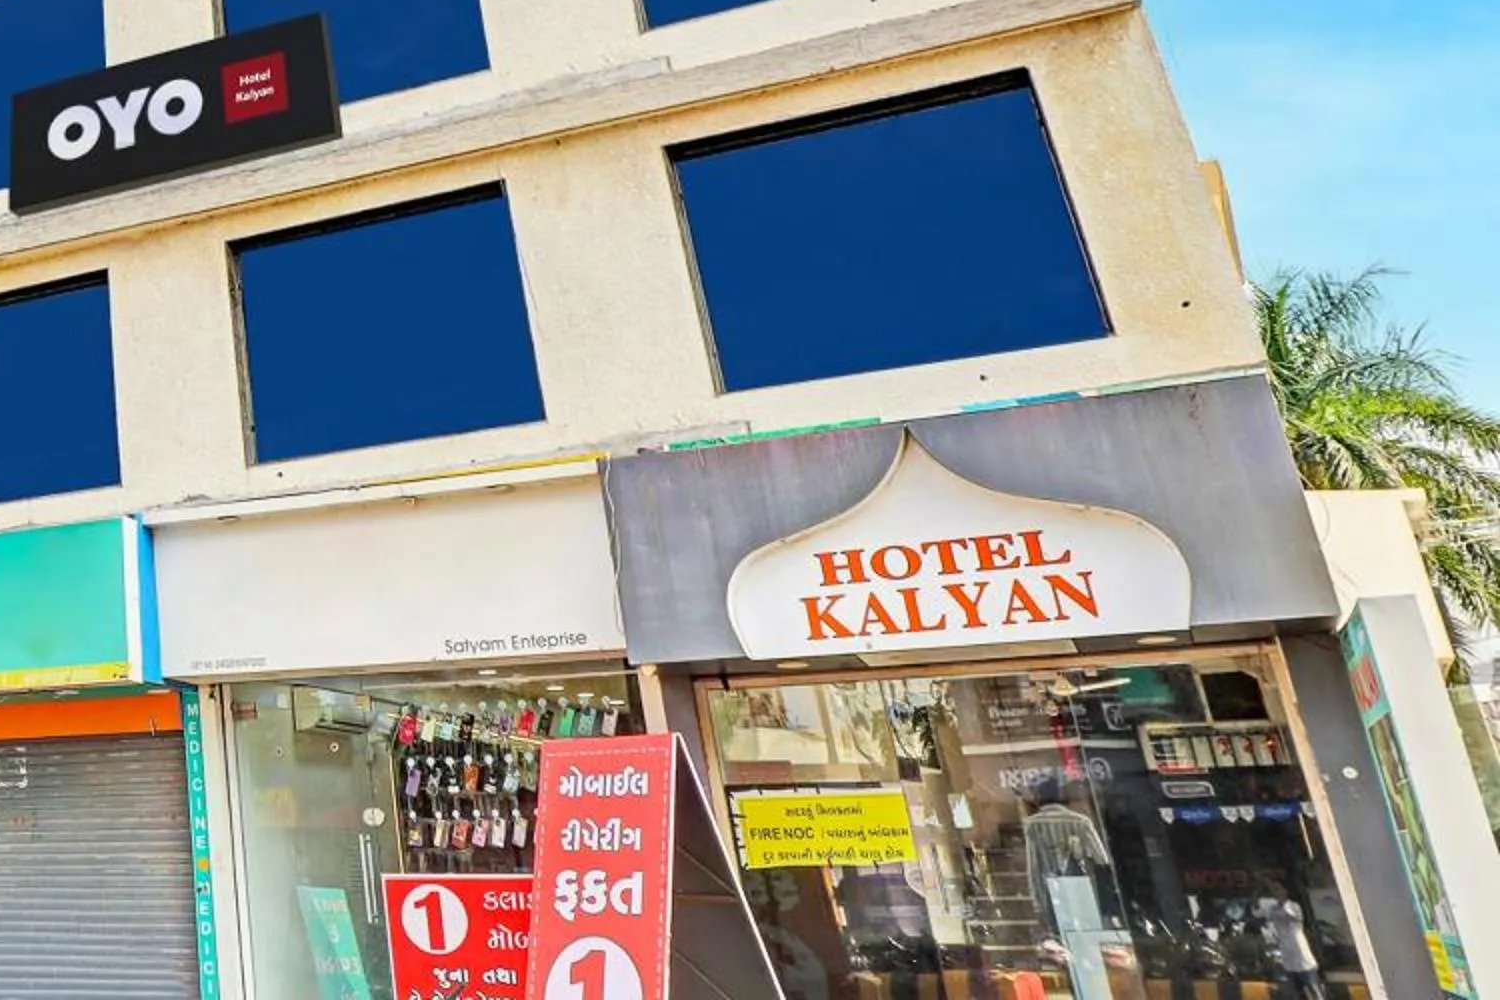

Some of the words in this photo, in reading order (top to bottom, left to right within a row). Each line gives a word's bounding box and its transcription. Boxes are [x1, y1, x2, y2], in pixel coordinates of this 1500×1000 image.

[235, 84, 276, 105] Kalyan
[239, 69, 271, 87] Hotel
[48, 79, 203, 161] OYO
[813, 530, 1071, 588] HOTEL
[800, 571, 1101, 642] KALYAN
[444, 638, 507, 655] Satyam
[510, 631, 588, 650] Enteprise
[186, 702, 207, 850] MEDICINE
[559, 766, 649, 798] મોબાઈલ
[750, 828, 781, 841] FIRE
[782, 827, 815, 840] NOC
[413, 891, 447, 951] 1
